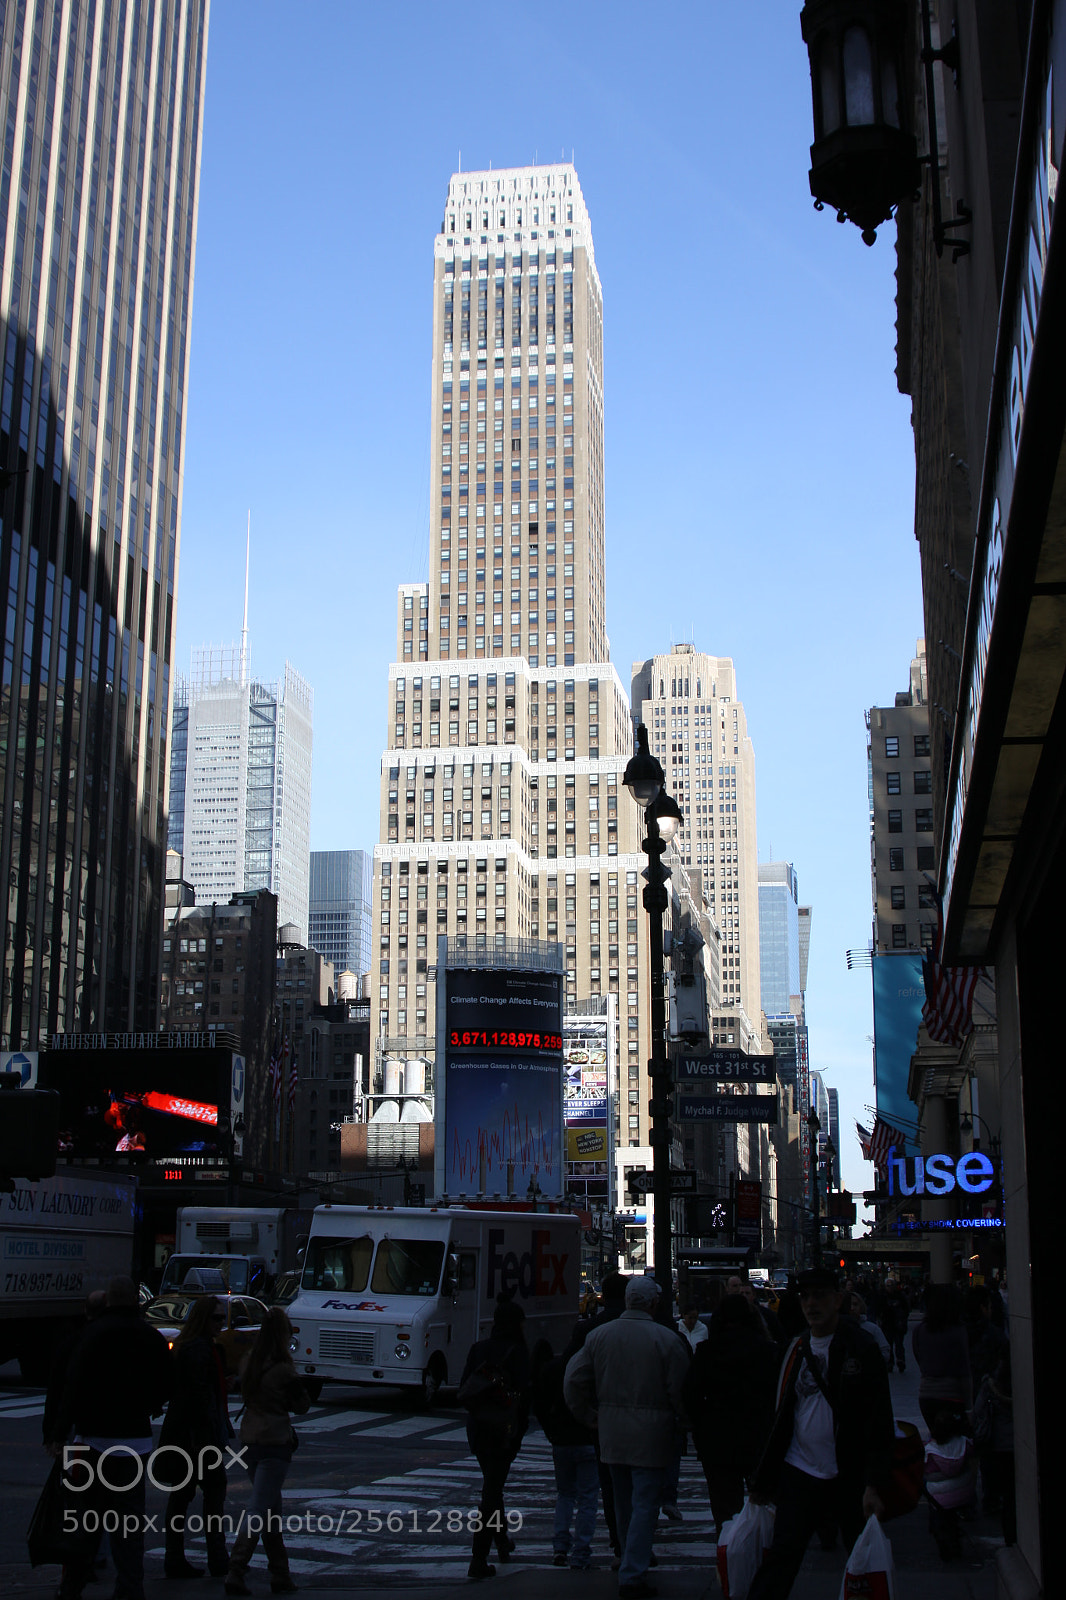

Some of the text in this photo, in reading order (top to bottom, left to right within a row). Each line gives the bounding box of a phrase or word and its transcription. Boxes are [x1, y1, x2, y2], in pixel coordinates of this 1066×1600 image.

[450, 996, 559, 1008] Climate Change Affects Everyone
[52, 1032, 216, 1050] MADISON SQUARE GARDEN
[450, 1031, 562, 1050] 3,671,128,975,259
[685, 1060, 767, 1076] West 31st St
[685, 1105, 715, 1118] Mychal
[724, 1106, 749, 1118] Judge
[750, 1107, 770, 1118] Way
[584, 1132, 596, 1140] NBC
[589, 1136, 603, 1145] YORK
[164, 1170, 182, 1180] 11:11
[887, 1145, 994, 1196] fuse
[638, 1177, 655, 1187] ON
[9, 1189, 37, 1212] SUN
[40, 1191, 97, 1216] LAUNDRY
[956, 1218, 1002, 1228] COVERING
[9, 1241, 83, 1257] HOTEL DIVISION
[487, 1229, 569, 1299] FedEx
[5, 1272, 83, 1293] 718/937-0428
[321, 1299, 388, 1313] FedEx
